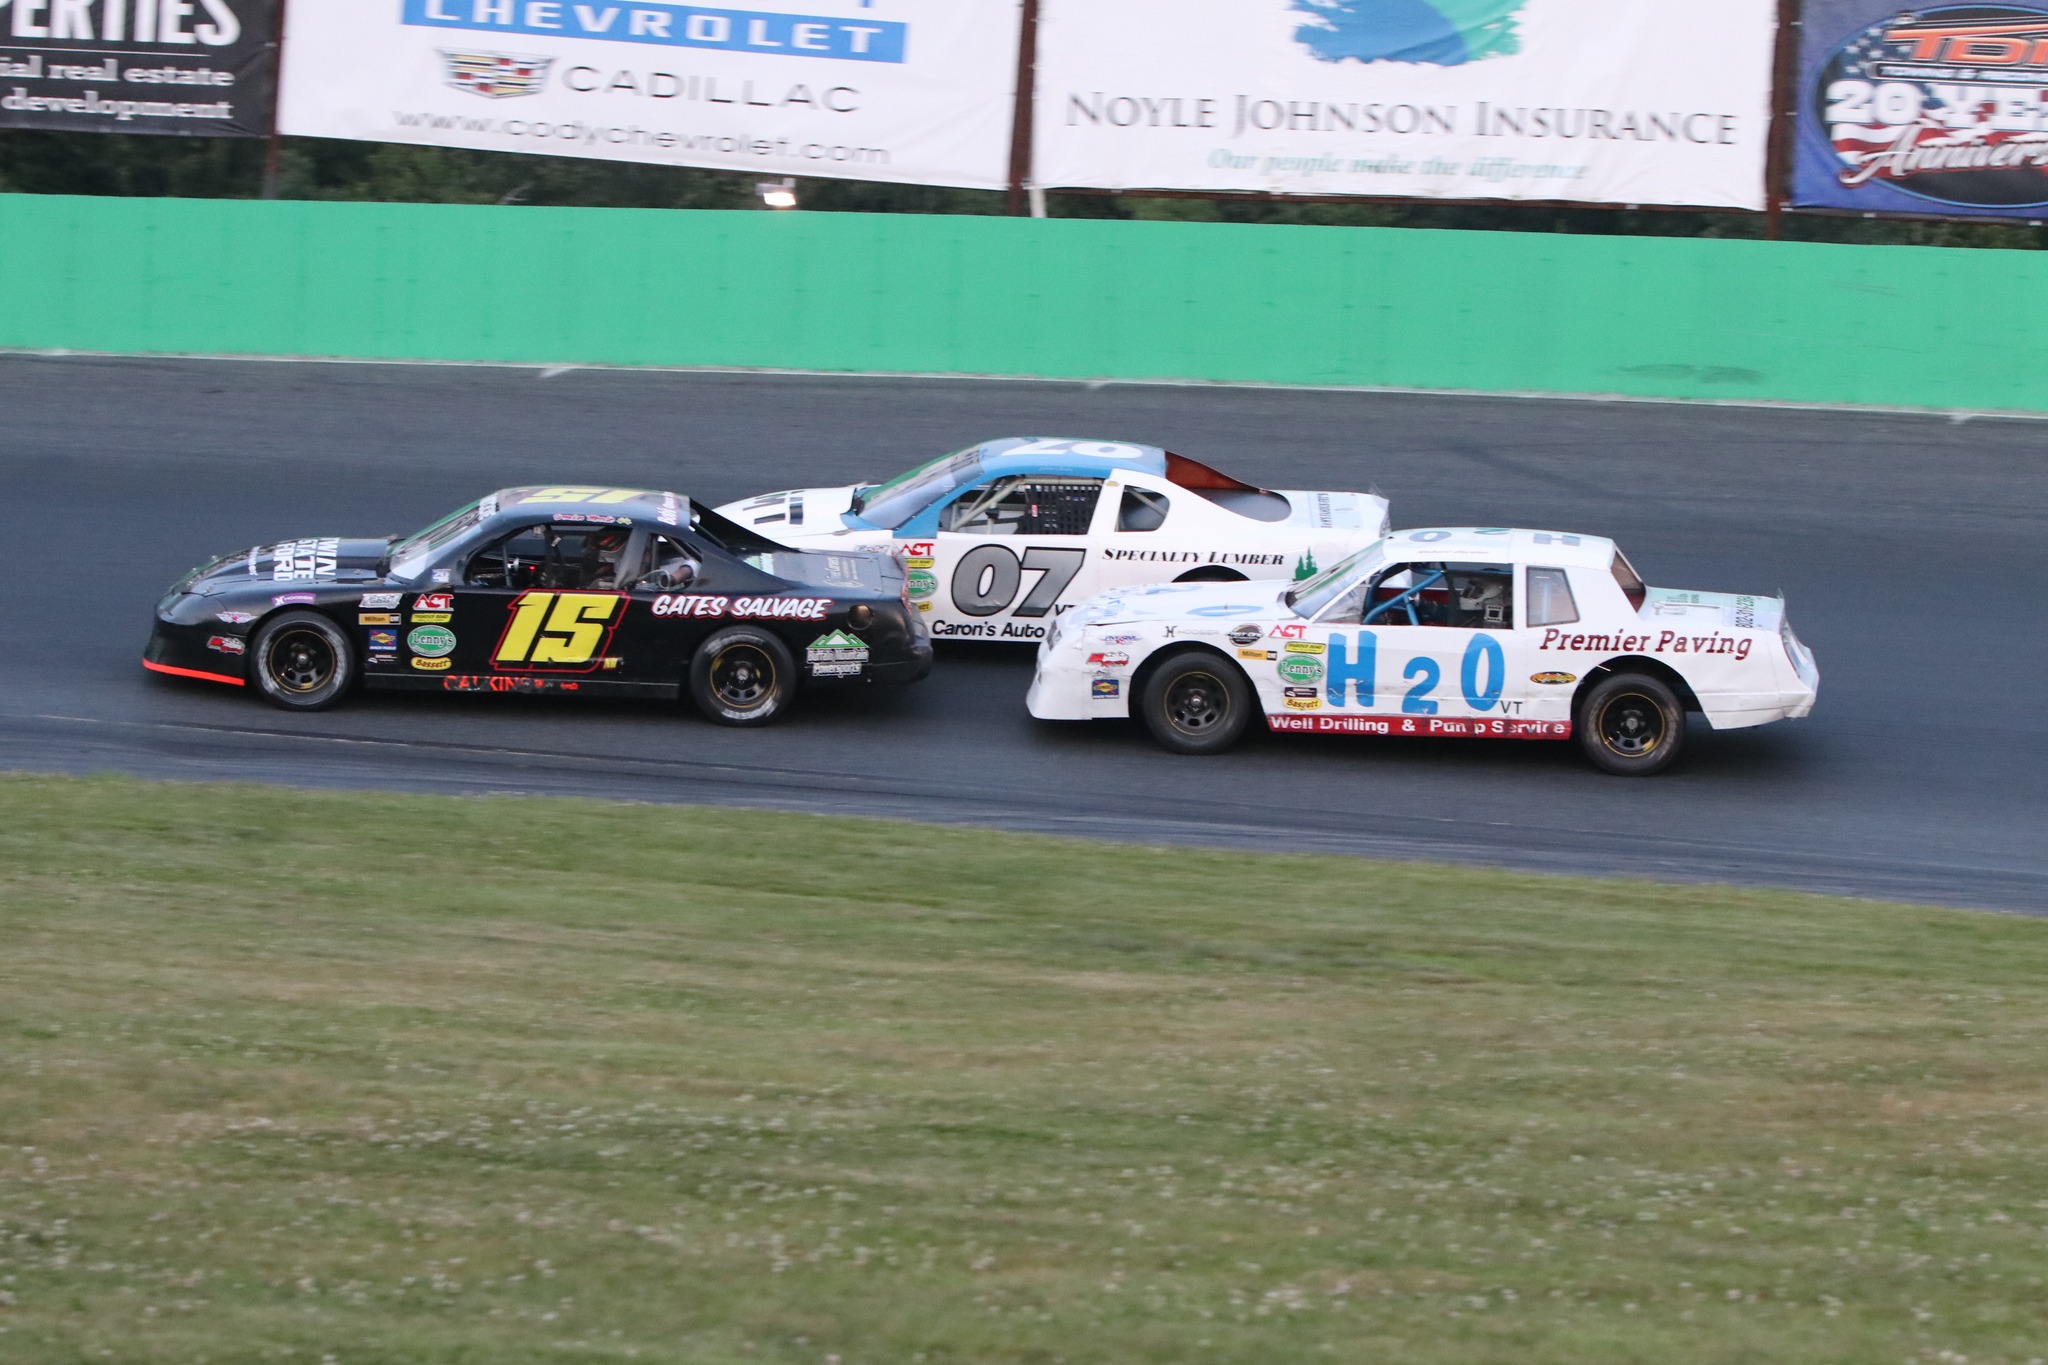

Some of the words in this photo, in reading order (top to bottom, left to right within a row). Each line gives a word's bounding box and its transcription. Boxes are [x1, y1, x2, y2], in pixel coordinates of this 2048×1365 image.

[424, 0, 884, 53] CHEVROLET
[48, 59, 119, 81] real
[123, 66, 236, 86] estate
[562, 65, 861, 113] CADILLAC
[1825, 79, 1922, 125] 20
[1, 87, 235, 121] development
[1066, 91, 1218, 128] NOYLE
[1230, 94, 1458, 138] JOHNSON
[1475, 101, 1739, 145] INSURANCE
[391, 109, 892, 165] www.codychevrolet.com
[1206, 148, 1257, 170] Our
[1259, 153, 1341, 177] people
[1349, 154, 1414, 175] make
[1421, 156, 1459, 175] the
[1467, 156, 1589, 183] difference
[273, 542, 297, 581] FORD
[901, 543, 936, 556] ACT
[1102, 548, 1203, 563] SPECIALTY
[1208, 551, 1285, 565] LUMBER
[908, 577, 937, 591] nny's
[951, 543, 1087, 618] 07
[413, 593, 454, 609] ACT
[652, 594, 724, 617] GATES
[731, 597, 832, 619] SALVAGE
[413, 633, 453, 648] Lenny's
[496, 592, 620, 663] 15
[931, 619, 996, 637] Caron's
[1001, 622, 1045, 639] Auto
[1268, 624, 1308, 639] ACT
[1540, 628, 1651, 652] Premier
[1655, 630, 1753, 661] Paving
[415, 659, 448, 669] Bassett
[1282, 662, 1322, 677] Lenny's
[1500, 701, 1523, 715] VT
[1271, 715, 1313, 730] Well
[1320, 717, 1389, 734] Drilling
[1401, 718, 1415, 732] &
